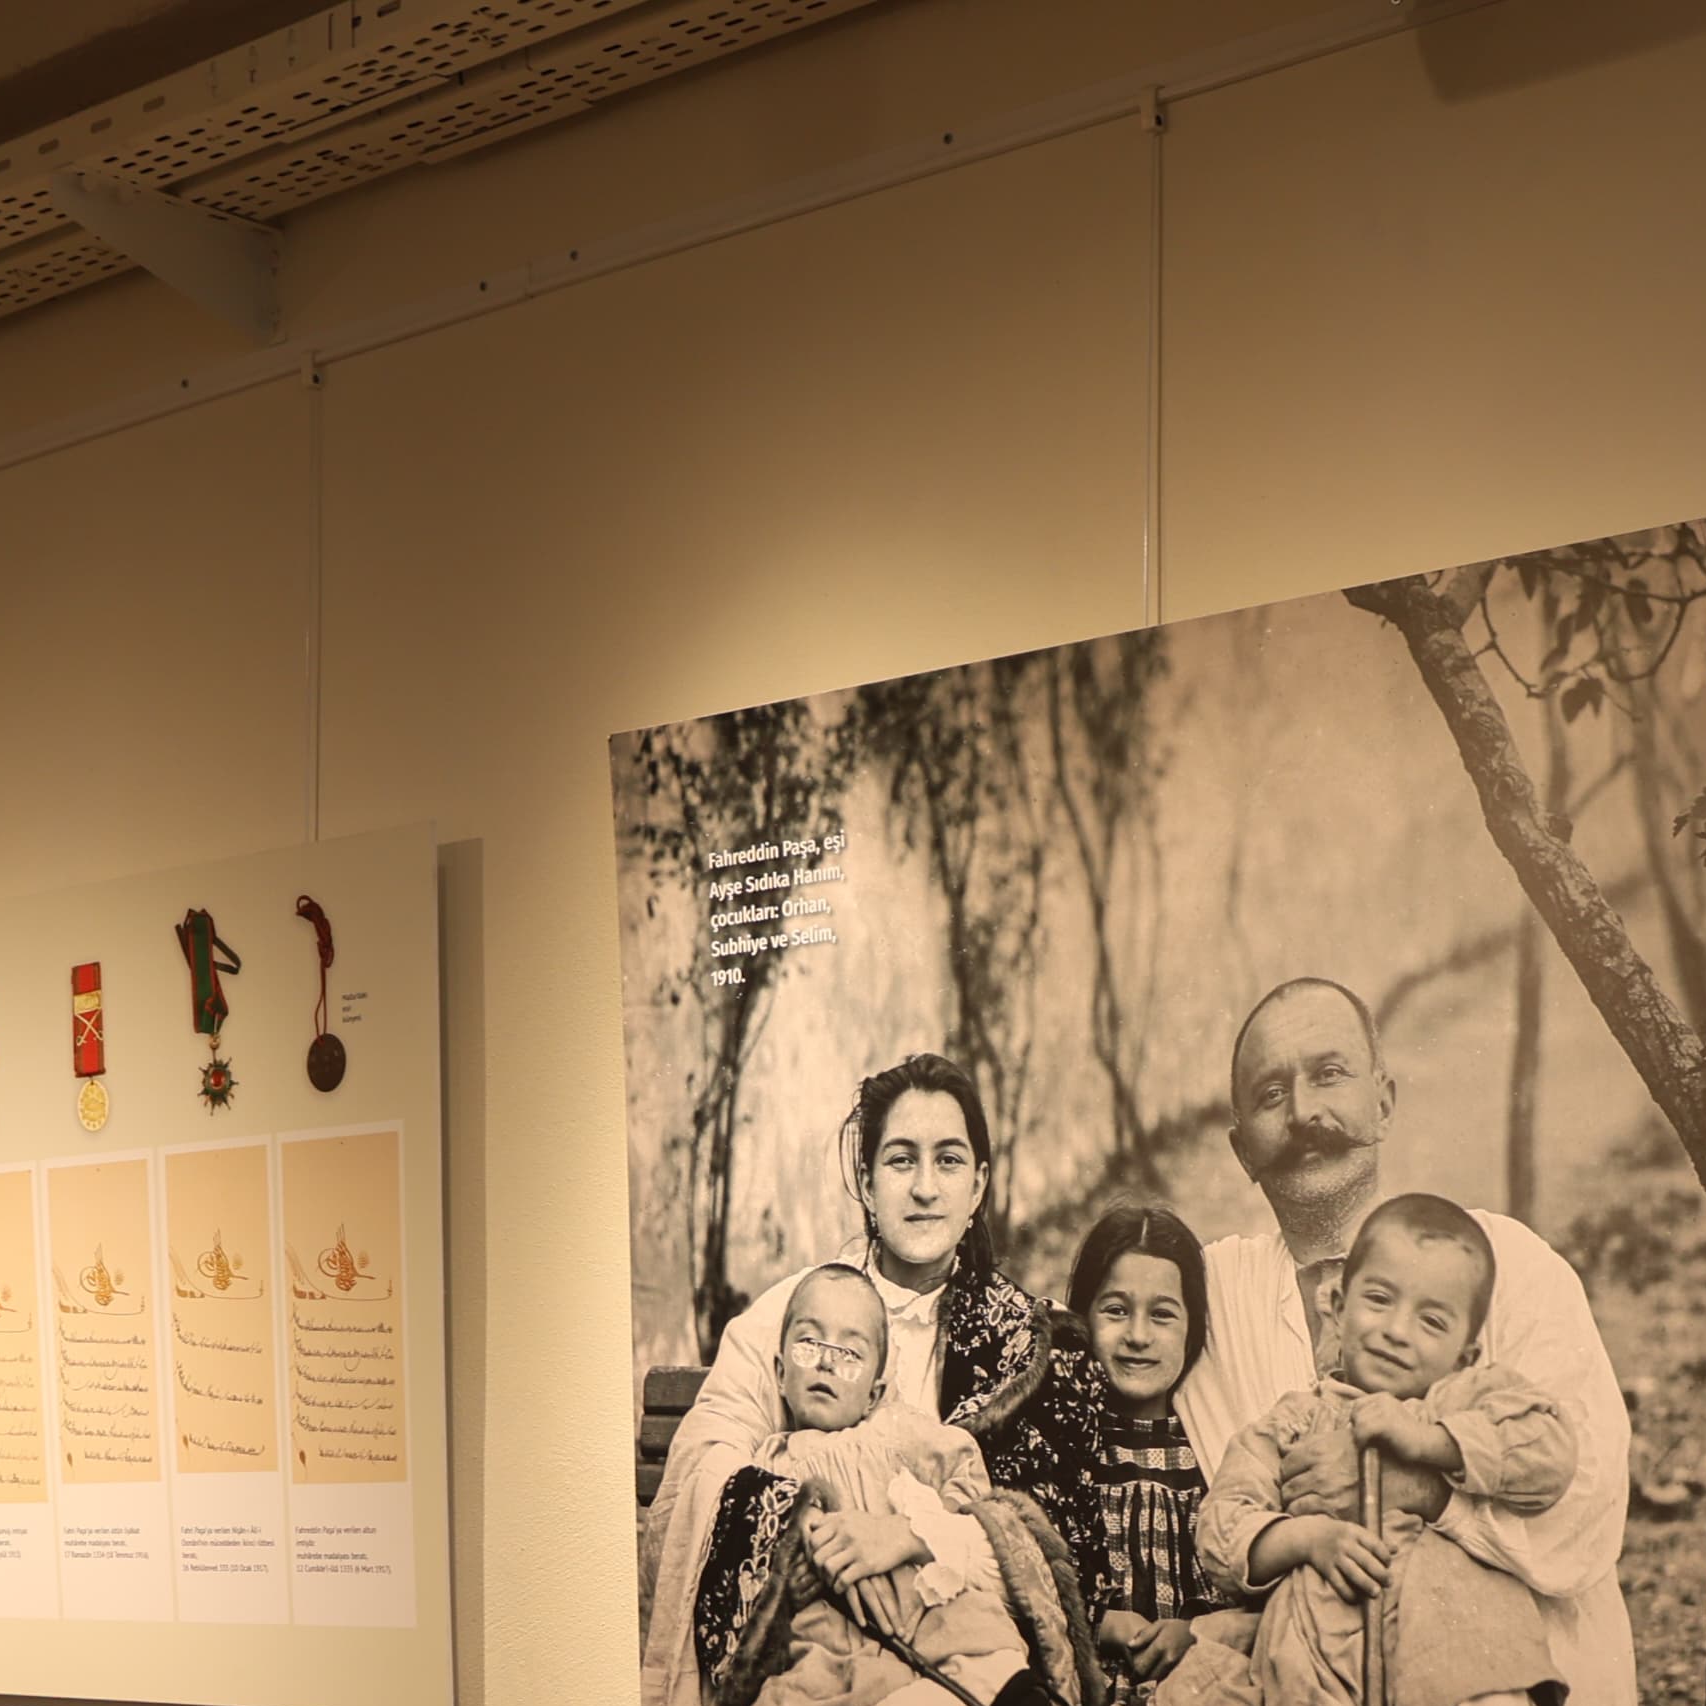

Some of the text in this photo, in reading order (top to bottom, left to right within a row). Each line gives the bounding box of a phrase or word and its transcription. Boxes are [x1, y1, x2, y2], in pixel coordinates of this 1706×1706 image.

[708, 829, 845, 870] Fahreddin Paşa, eşi
[709, 864, 845, 900] Ayşe Sıdıka Hanım,
[710, 896, 831, 932] çocukları: Orhan,
[710, 926, 837, 958] Subhiye ve Selim,
[710, 968, 746, 987] 1910.
